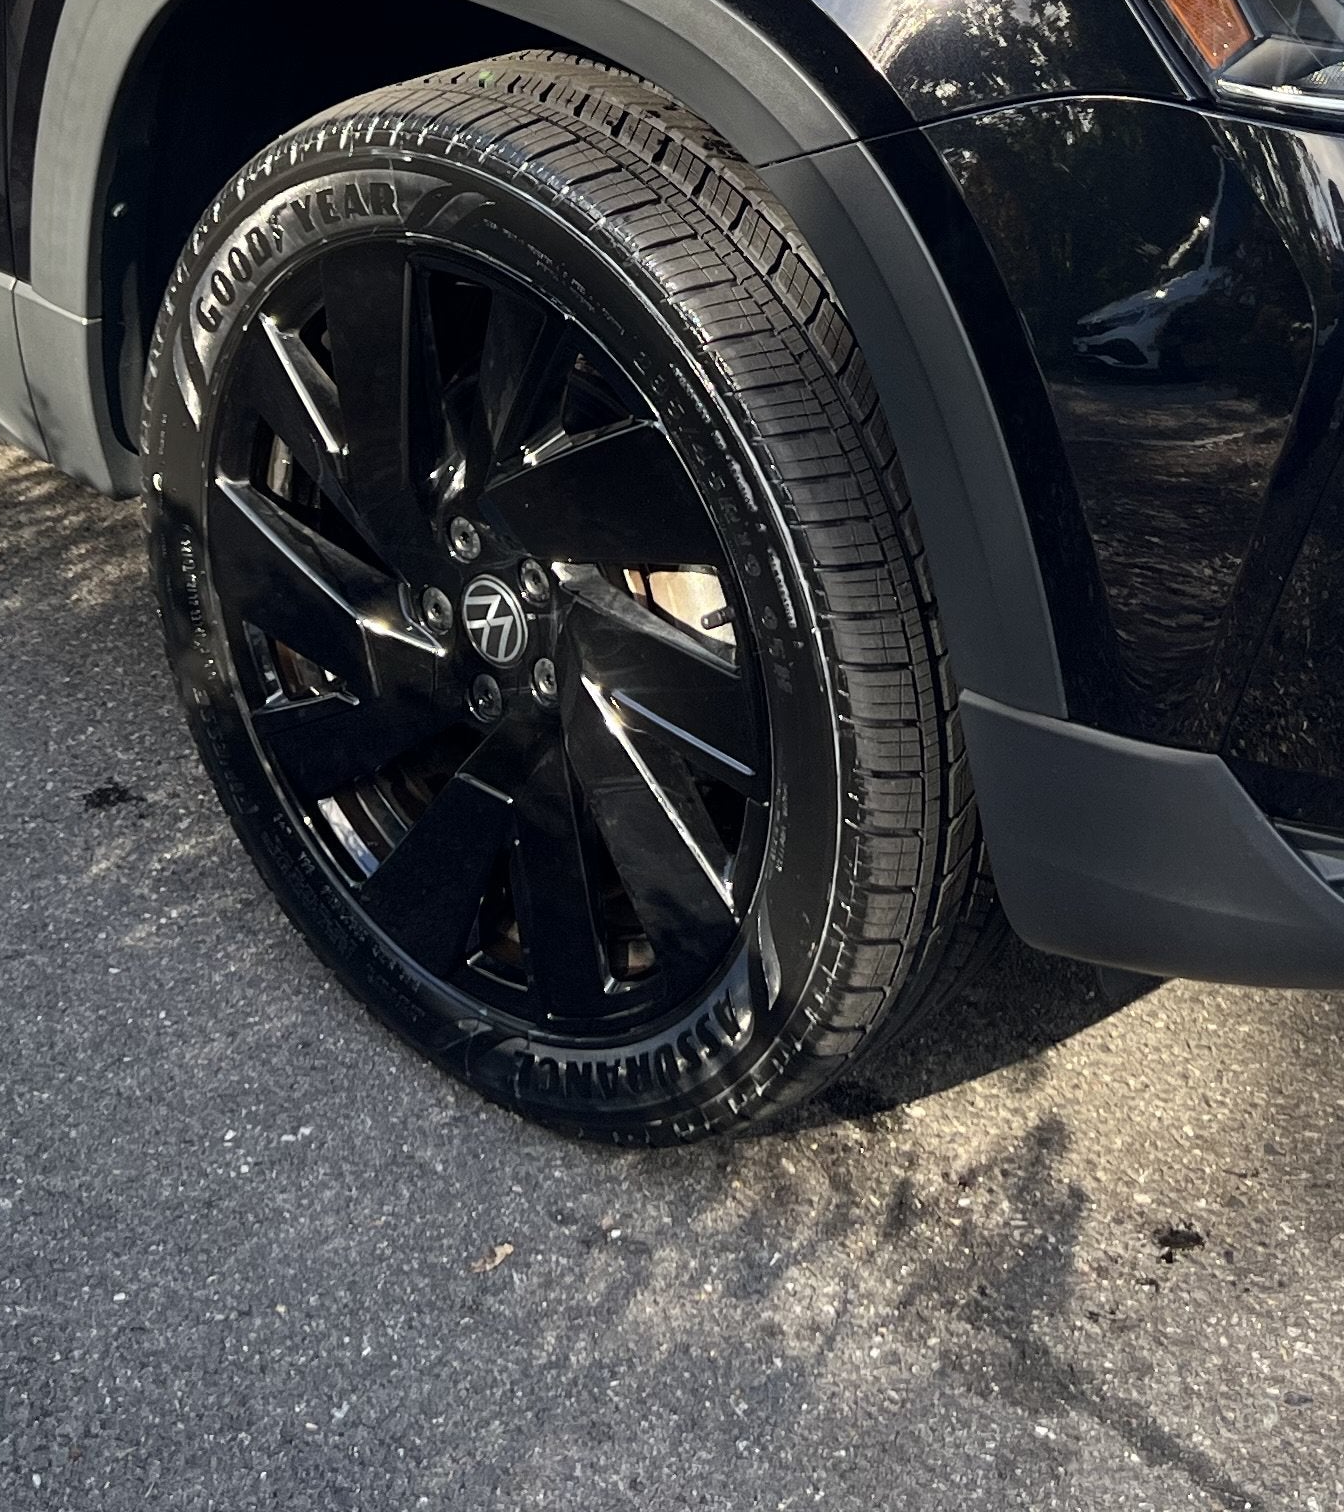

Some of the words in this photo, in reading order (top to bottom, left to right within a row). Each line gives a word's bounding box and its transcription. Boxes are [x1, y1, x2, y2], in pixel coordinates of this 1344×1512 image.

[196, 182, 404, 333] GOODYEAR
[463, 574, 528, 669] VW
[513, 988, 742, 1100] ASSURANCE
